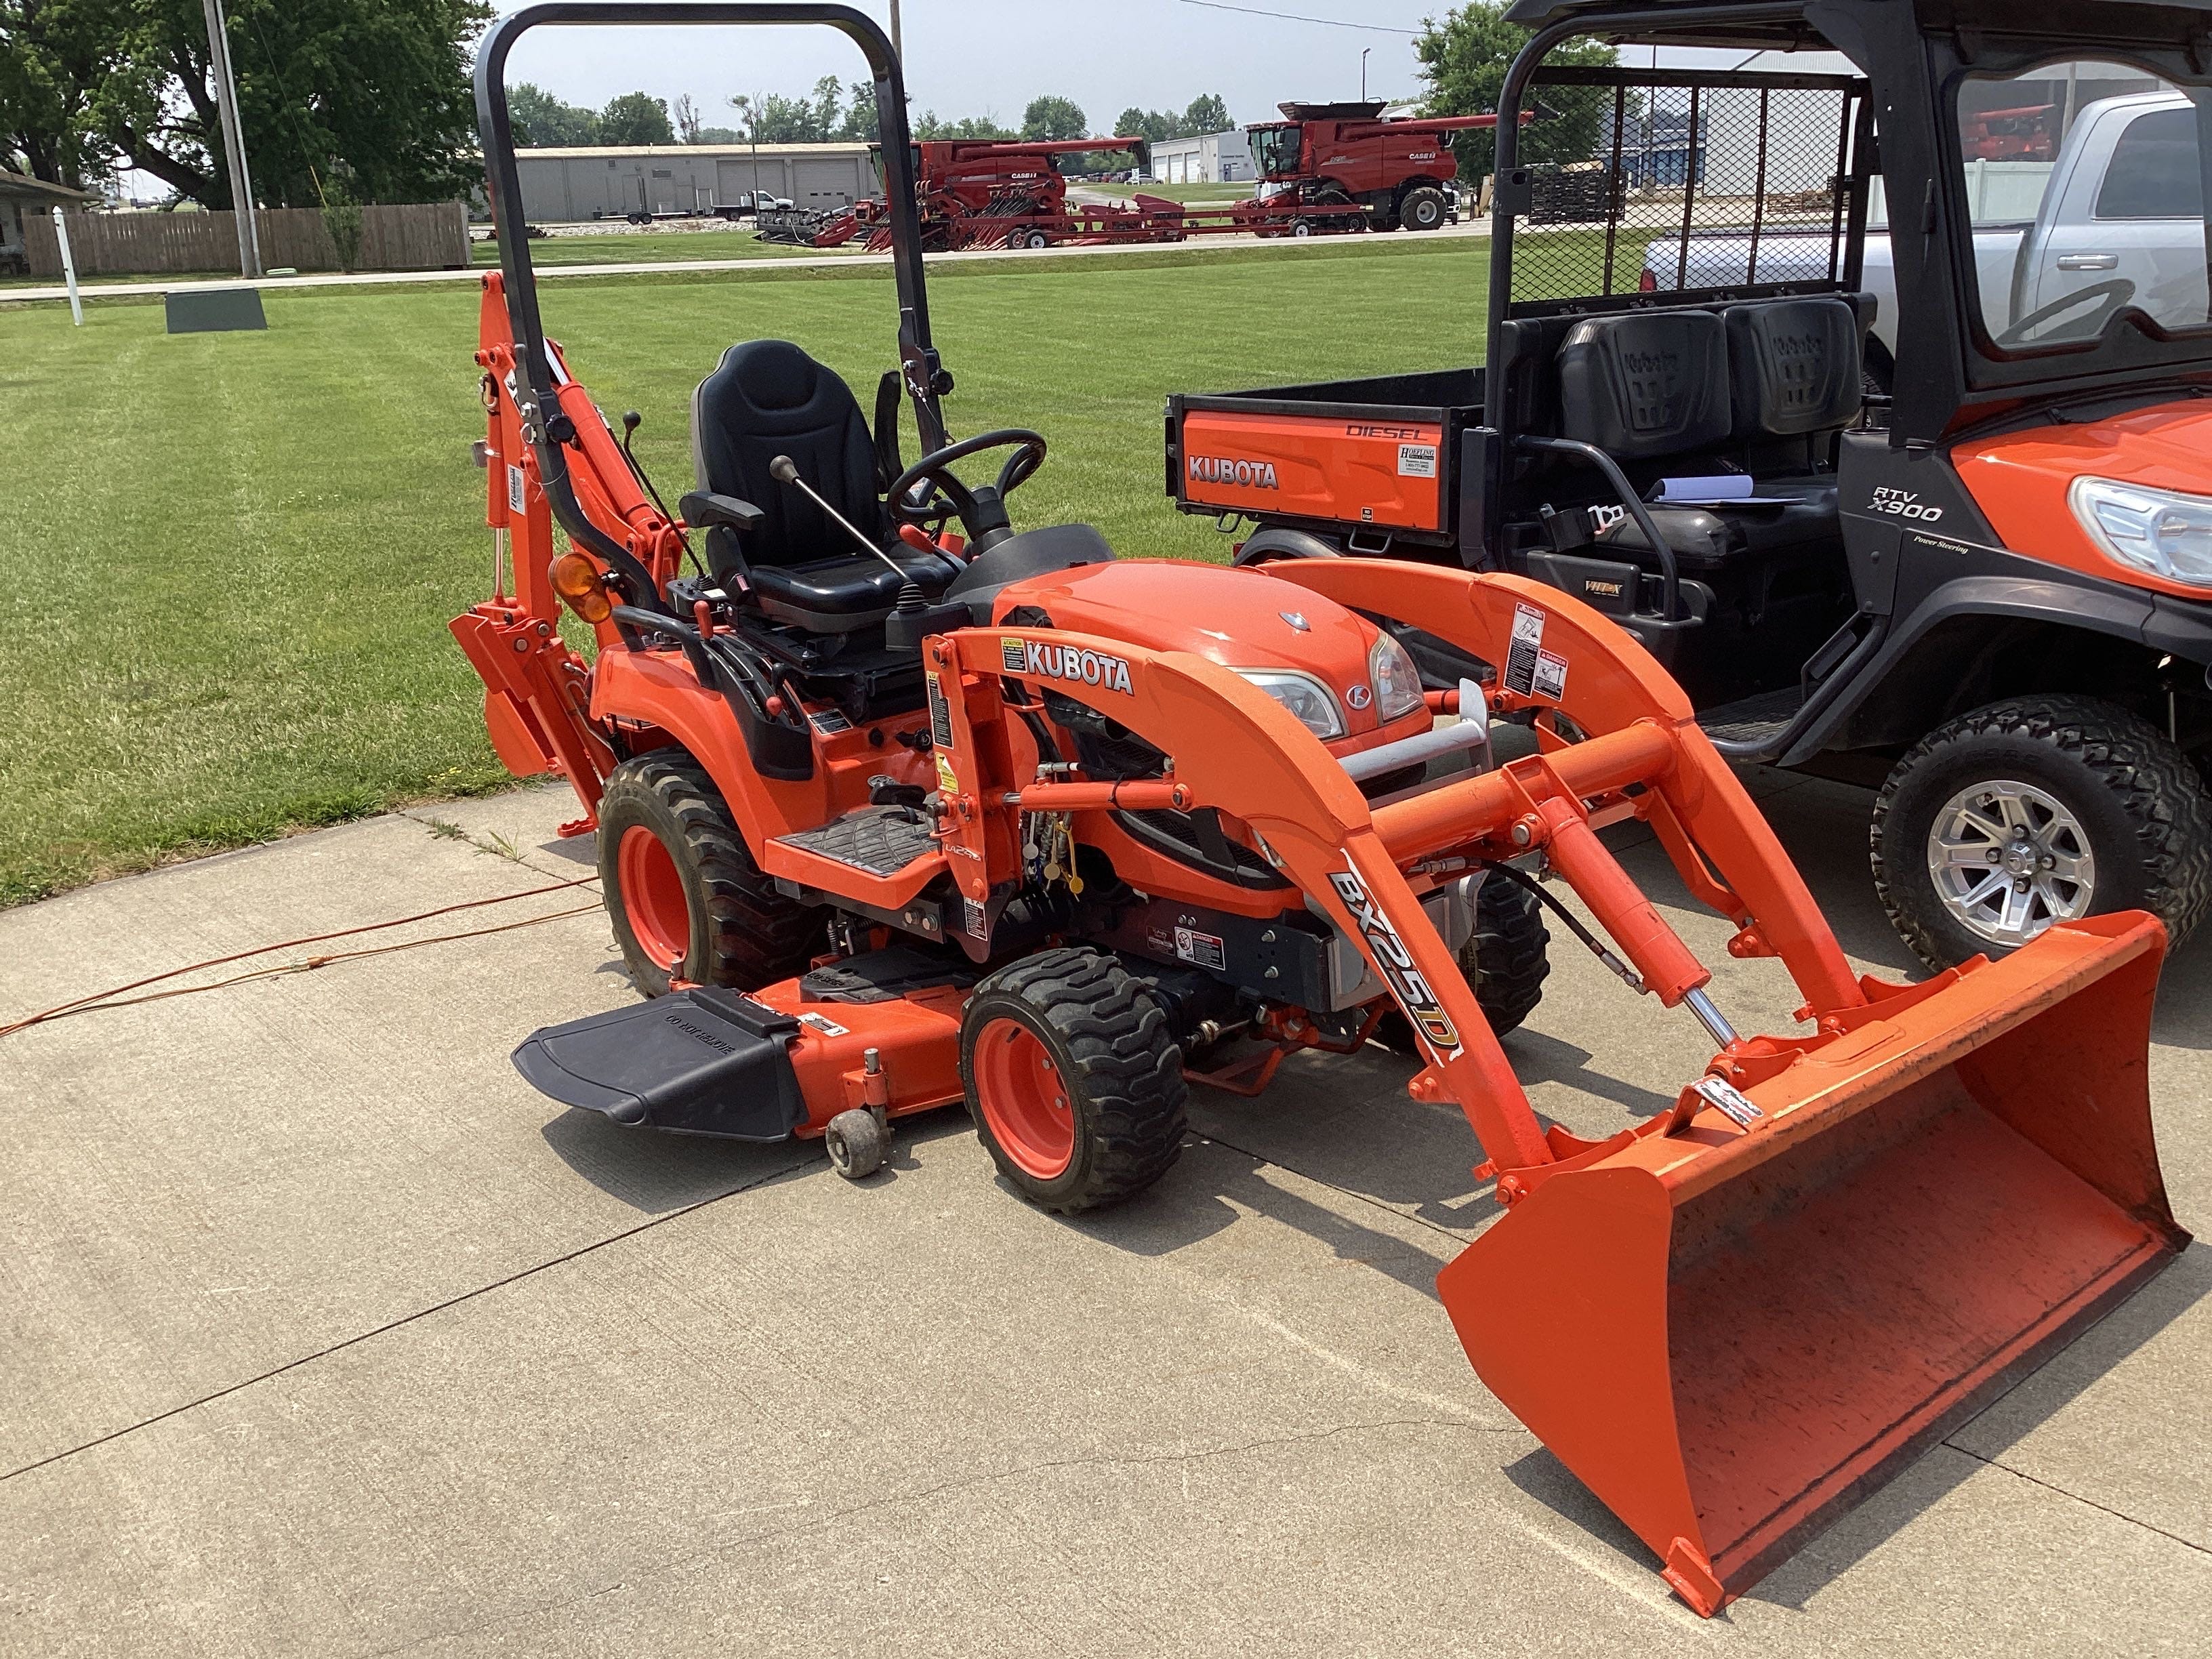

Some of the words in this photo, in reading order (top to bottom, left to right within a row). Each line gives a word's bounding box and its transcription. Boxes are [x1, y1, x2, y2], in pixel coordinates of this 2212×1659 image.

[1346, 425, 1428, 441] DIESEL
[1189, 455, 1279, 490] KUBOTA
[1866, 497, 1943, 522] X900
[1873, 486, 1918, 503] RTV
[1913, 535, 1938, 546] Power
[1936, 540, 1969, 555] Steering
[1026, 642, 1135, 697] KUBOTA
[1326, 872, 1460, 1050] BX25D
[665, 1015, 682, 1025] DO
[678, 1022, 701, 1035] NOT
[695, 1032, 736, 1055] REMOVE
